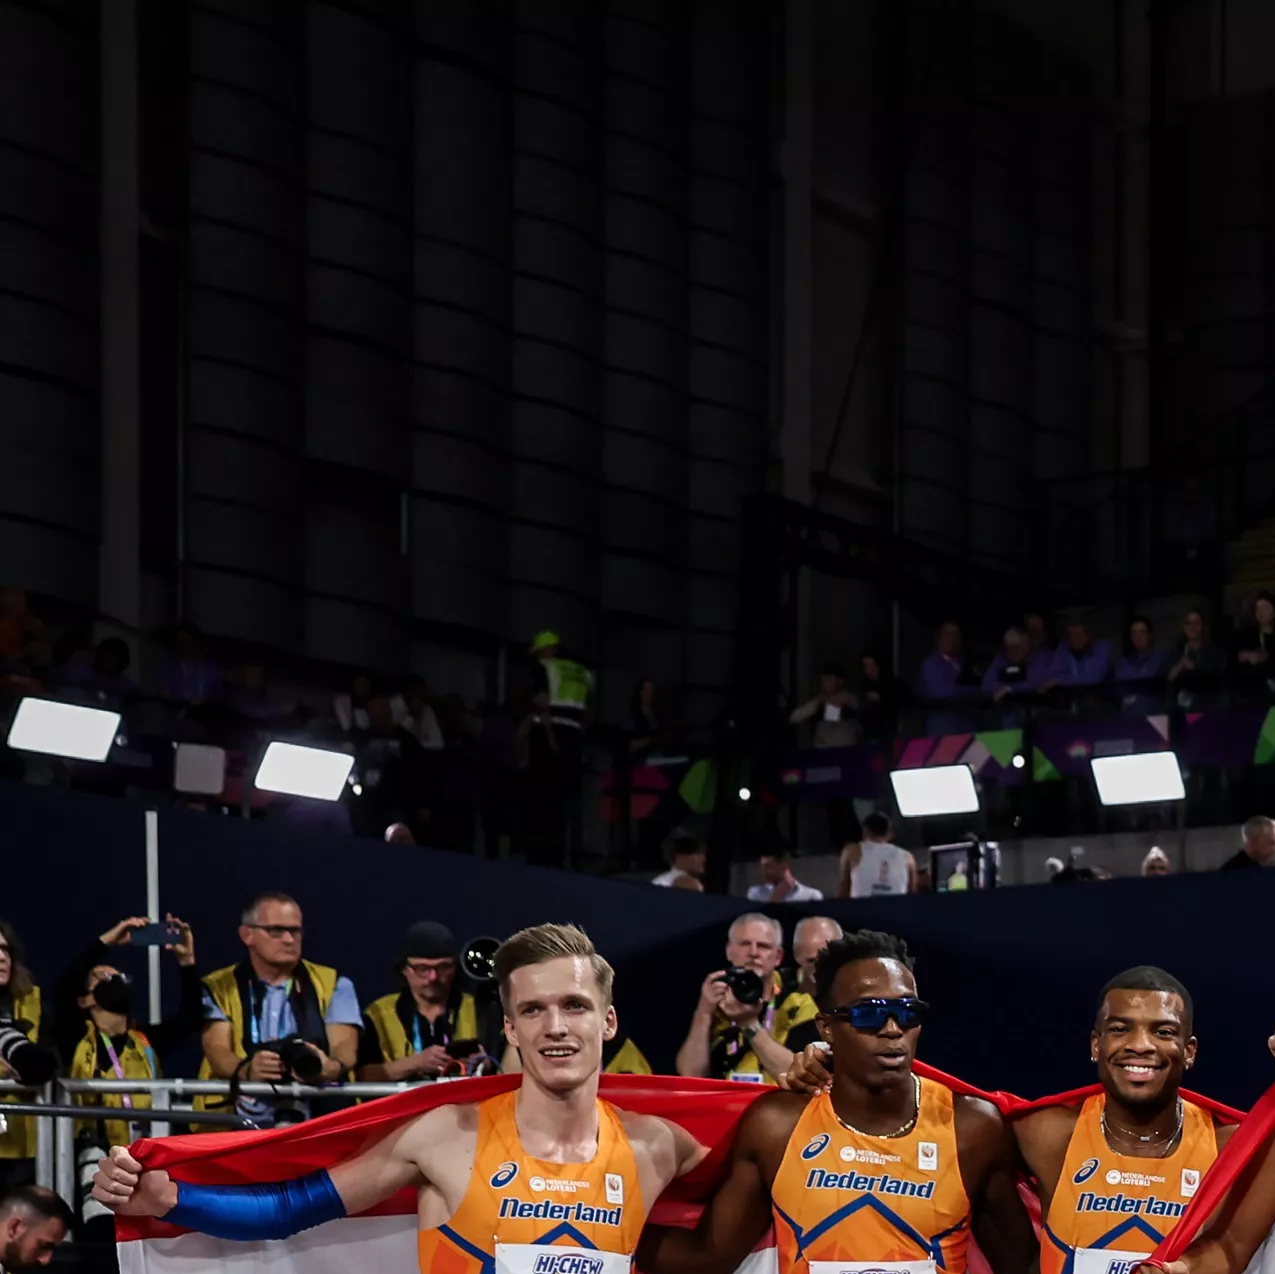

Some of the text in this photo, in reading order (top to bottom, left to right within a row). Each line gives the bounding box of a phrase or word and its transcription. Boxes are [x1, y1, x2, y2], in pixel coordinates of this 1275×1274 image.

[806, 1168, 934, 1199] Nederland
[499, 1198, 622, 1226] Nederland
[1076, 1192, 1188, 1217] Nederlan
